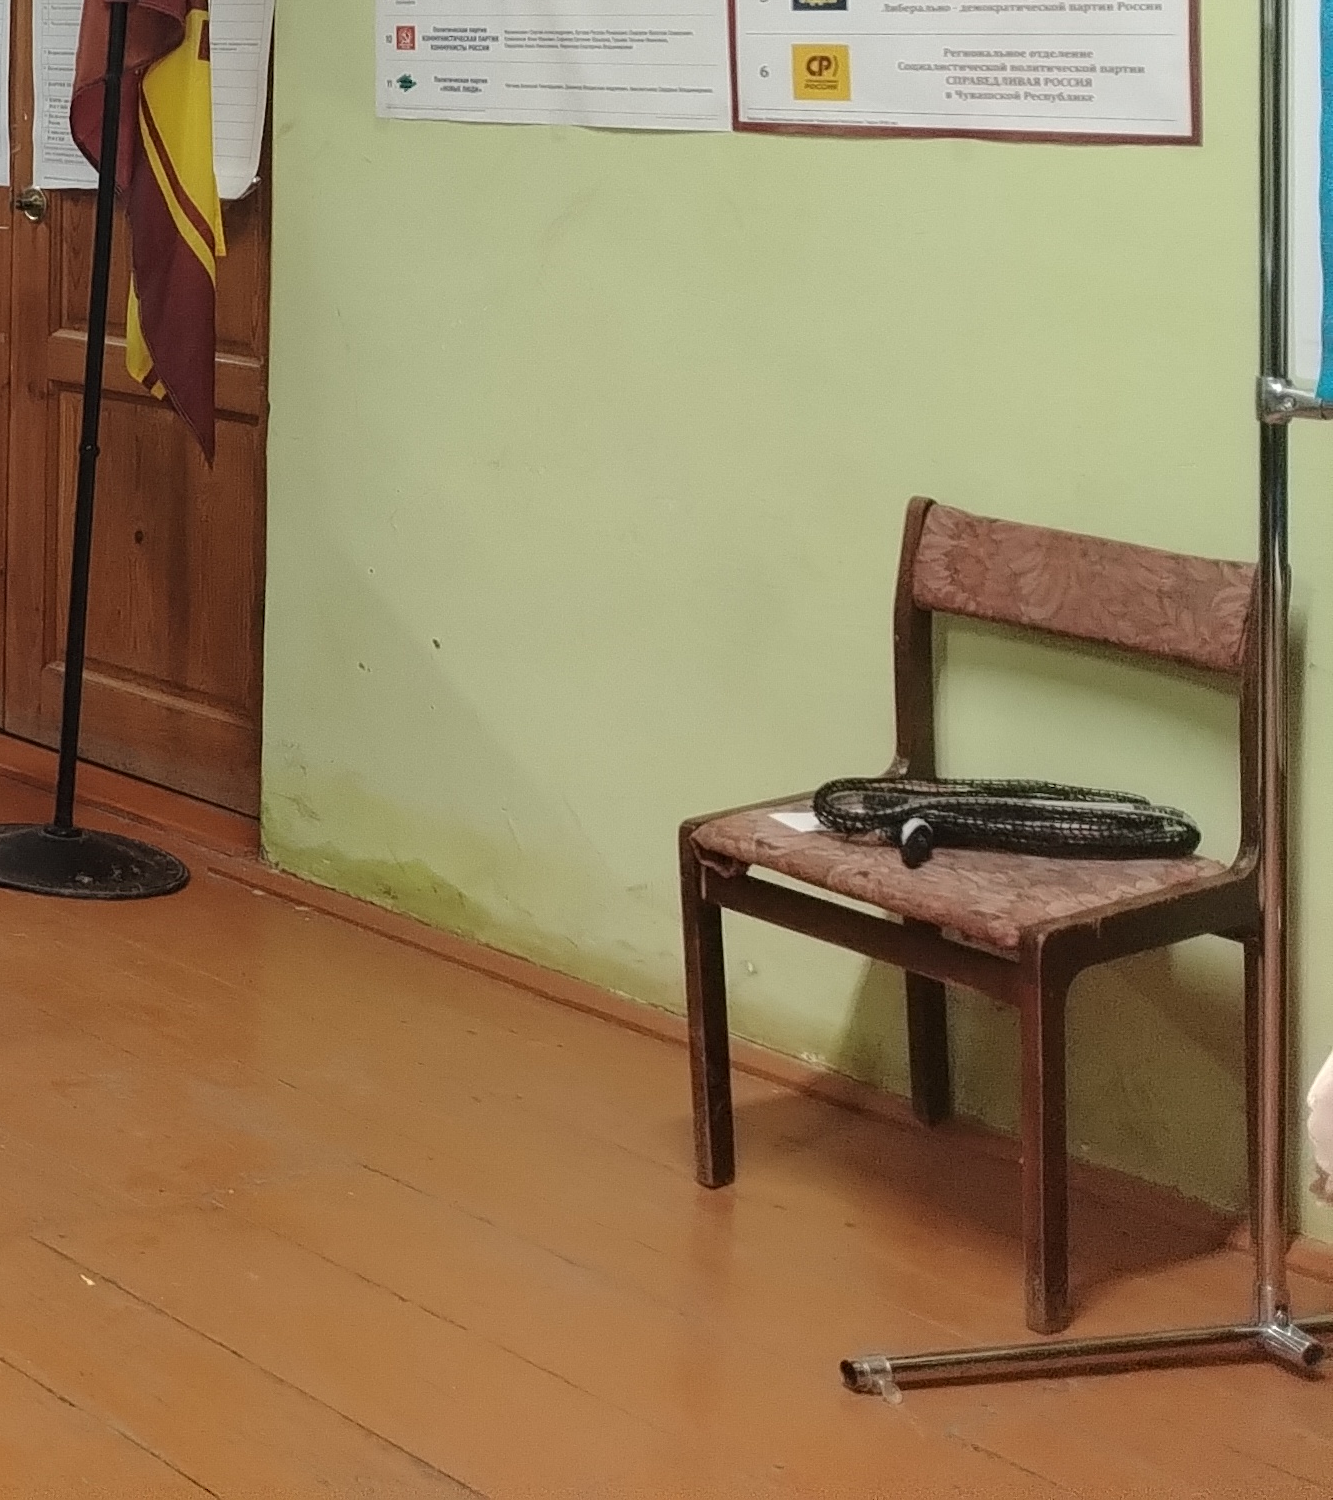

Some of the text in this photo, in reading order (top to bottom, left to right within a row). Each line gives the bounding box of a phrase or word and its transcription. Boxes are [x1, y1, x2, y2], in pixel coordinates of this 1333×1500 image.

[1069, 2, 1114, 14] партии
[1117, 1, 1162, 12] России
[943, 47, 1094, 60] Региональное отделение
[760, 65, 769, 78] 6
[897, 60, 1145, 76] Социалистической политической партии
[945, 75, 1093, 88] СПРАВЕДЛИВАЯ РОССИЯ
[954, 89, 1021, 102] Чувашской
[1023, 90, 1094, 103] Республике
